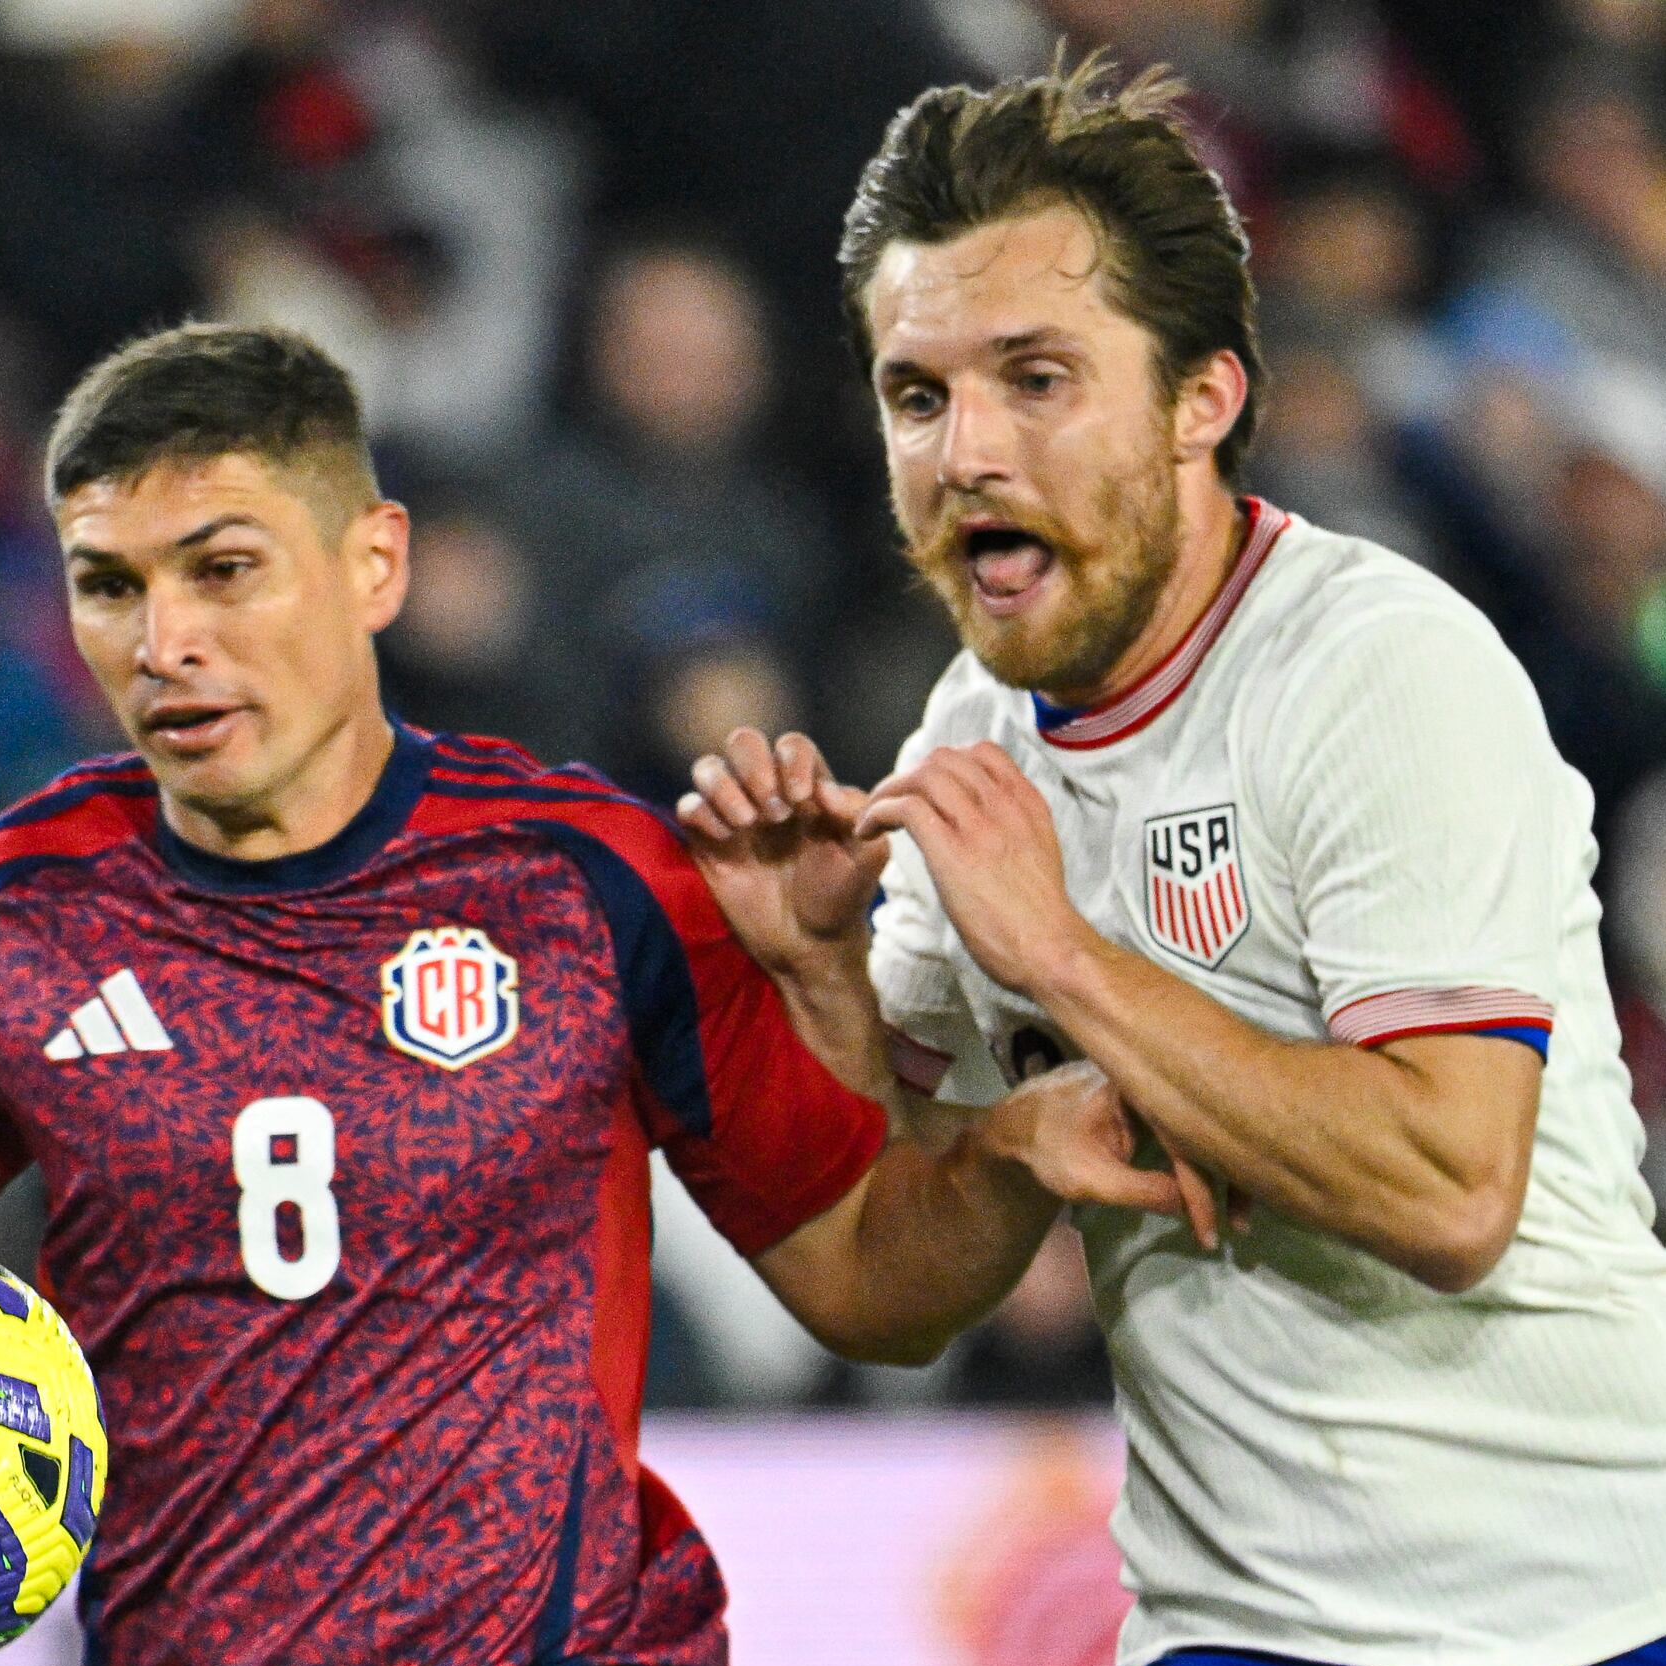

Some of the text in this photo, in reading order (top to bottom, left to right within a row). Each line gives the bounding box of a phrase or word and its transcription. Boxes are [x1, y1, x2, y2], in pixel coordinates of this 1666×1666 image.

[1152, 816, 1230, 878] USA
[416, 958, 485, 1039] CR
[232, 1095, 341, 1301] 8
